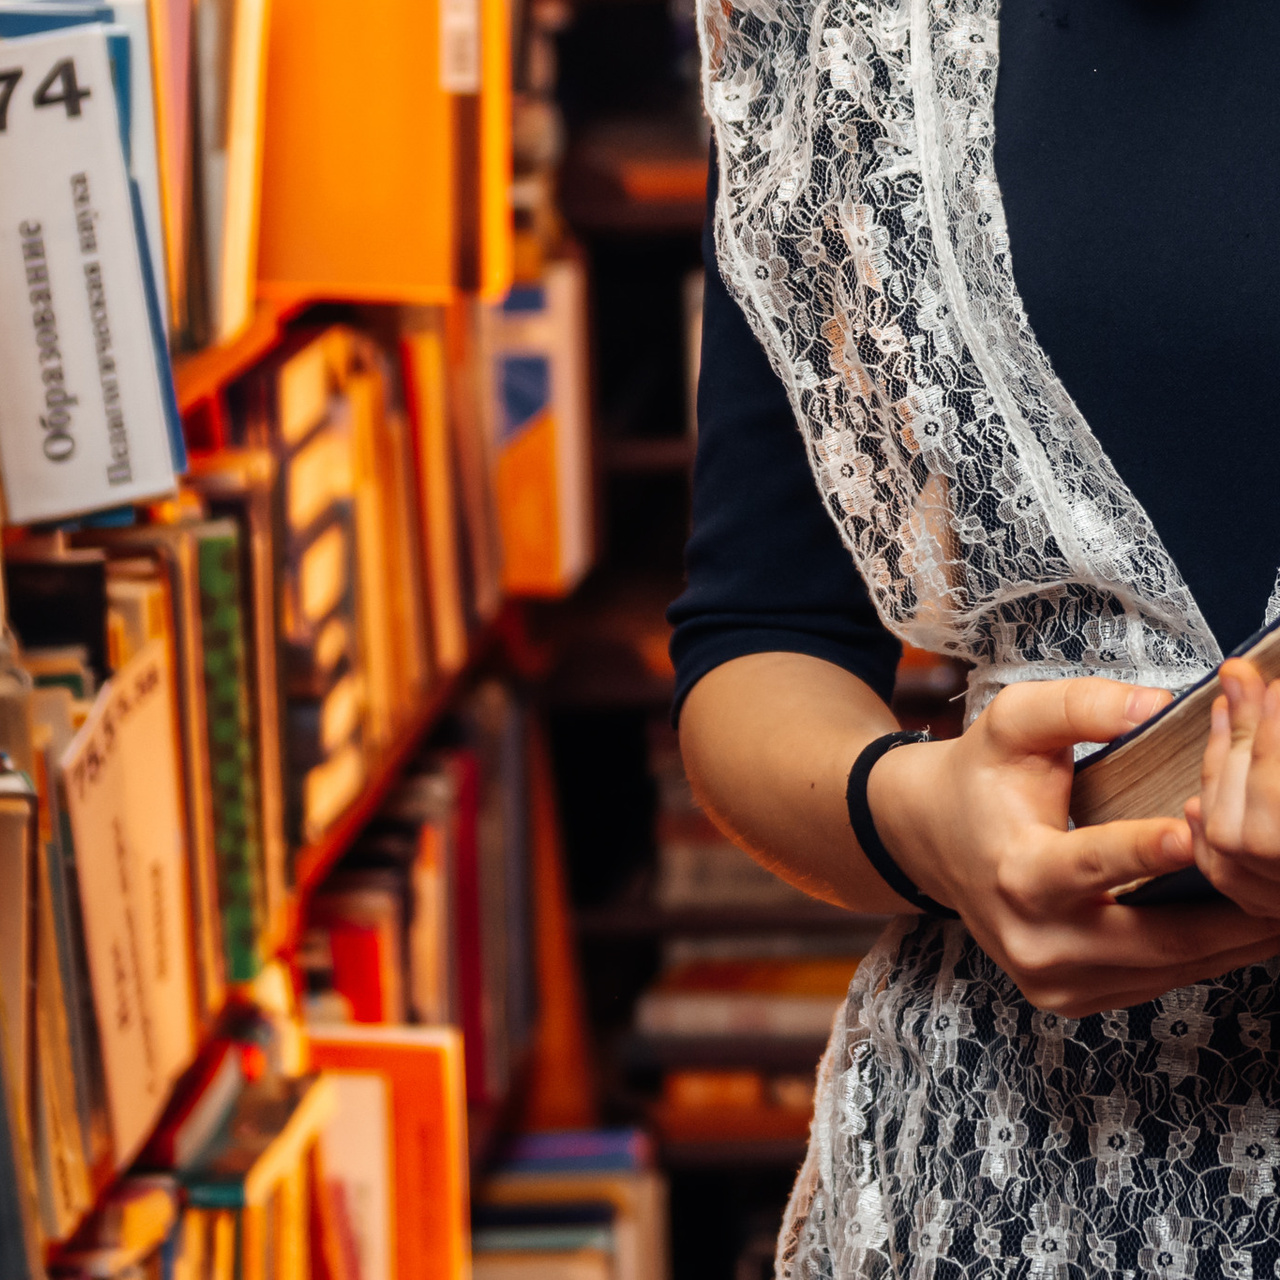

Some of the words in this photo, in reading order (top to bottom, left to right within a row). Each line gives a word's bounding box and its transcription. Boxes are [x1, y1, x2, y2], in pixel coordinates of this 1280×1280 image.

[0, 57, 91, 132] 74
[70, 172, 97, 254] наука
[18, 218, 78, 464] Образование
